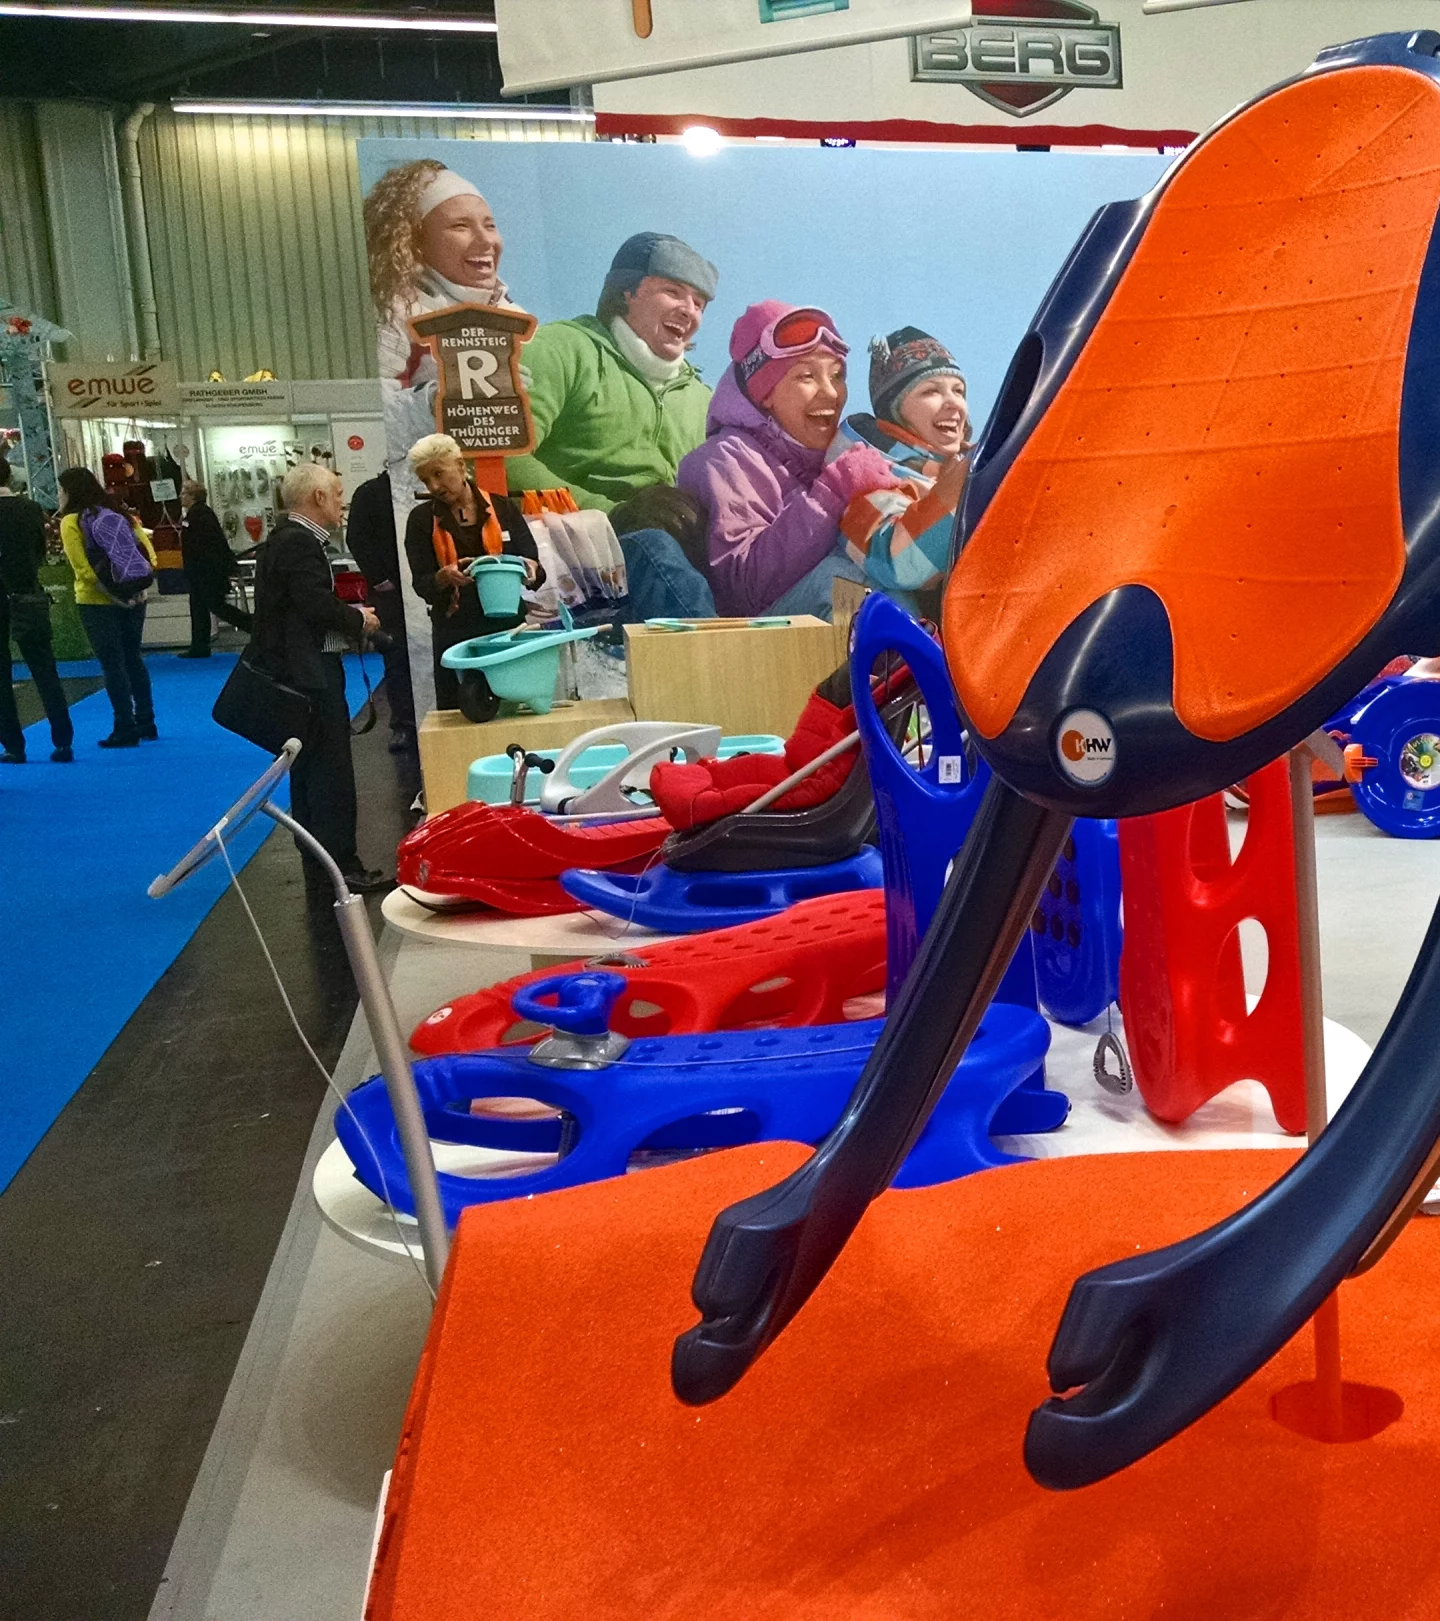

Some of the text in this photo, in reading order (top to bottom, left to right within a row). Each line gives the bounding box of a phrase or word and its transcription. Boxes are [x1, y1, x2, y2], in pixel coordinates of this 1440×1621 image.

[921, 28, 1111, 76] BERG
[461, 327, 485, 337] DER
[441, 337, 508, 347] RENNSTEIG
[456, 349, 499, 400] R
[67, 377, 155, 396] emwe
[189, 388, 268, 397] RATHGEBER GMBH
[447, 405, 519, 417] HÖHENWEG
[473, 416, 495, 426] DES
[450, 425, 520, 437] THÜRINGER
[462, 436, 511, 447] WALDES
[239, 445, 277, 454] emwe
[1075, 738, 1112, 753] KHW
